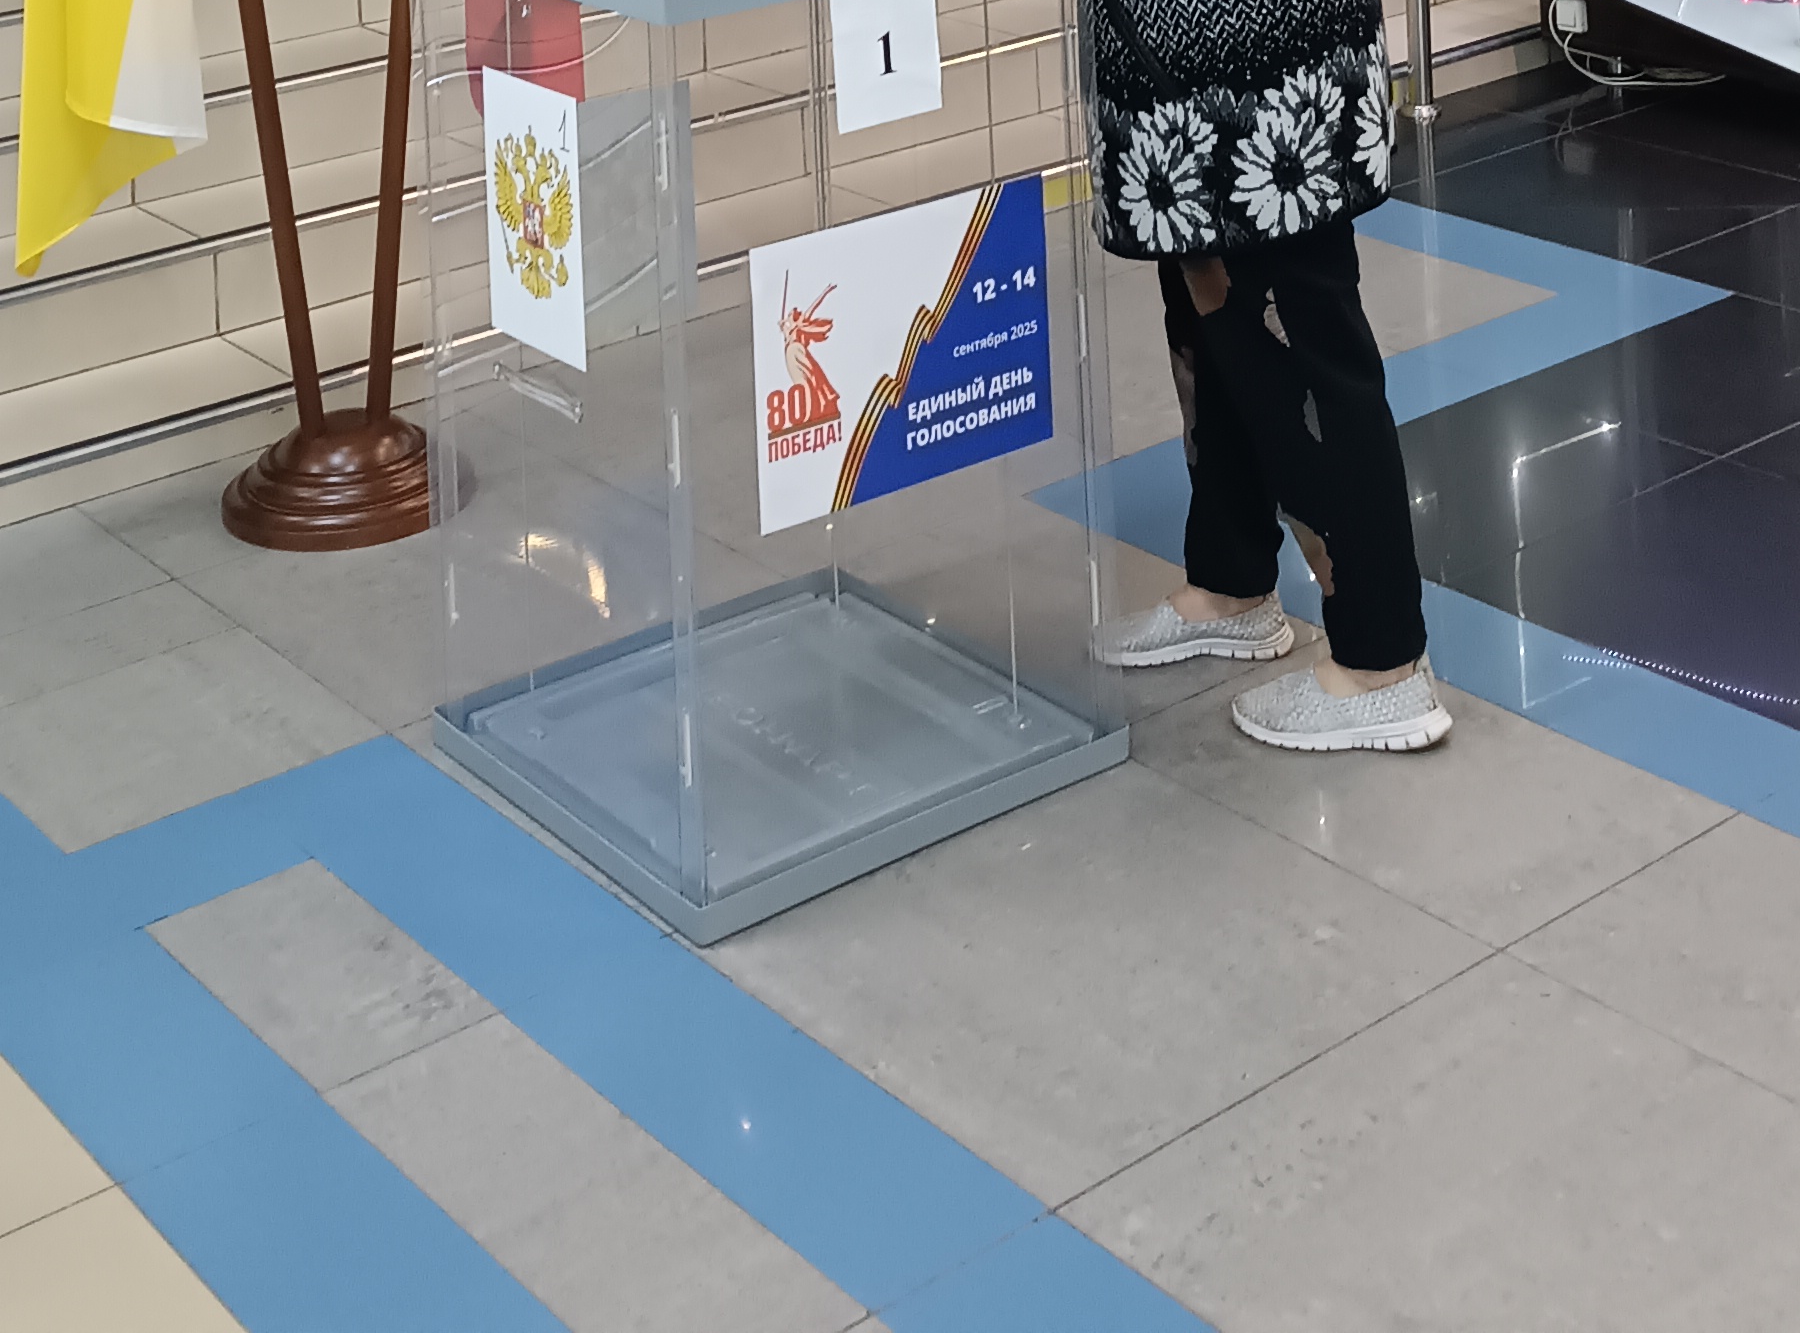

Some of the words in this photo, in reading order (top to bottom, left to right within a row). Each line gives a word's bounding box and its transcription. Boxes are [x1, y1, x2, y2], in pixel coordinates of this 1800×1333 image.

[876, 30, 898, 77] 1
[558, 108, 571, 153] 1
[972, 277, 997, 305] 12
[1012, 265, 1038, 293] 14
[952, 326, 1009, 359] сентября
[1009, 319, 1039, 344] 2025
[766, 383, 813, 434] 80
[907, 375, 987, 422] ЕДИНЫЙ
[988, 366, 1034, 402] ДЕНЬ
[767, 420, 843, 464] ПОБЕДА!
[906, 391, 1038, 451] ГОЛОСОВАНИЯ
